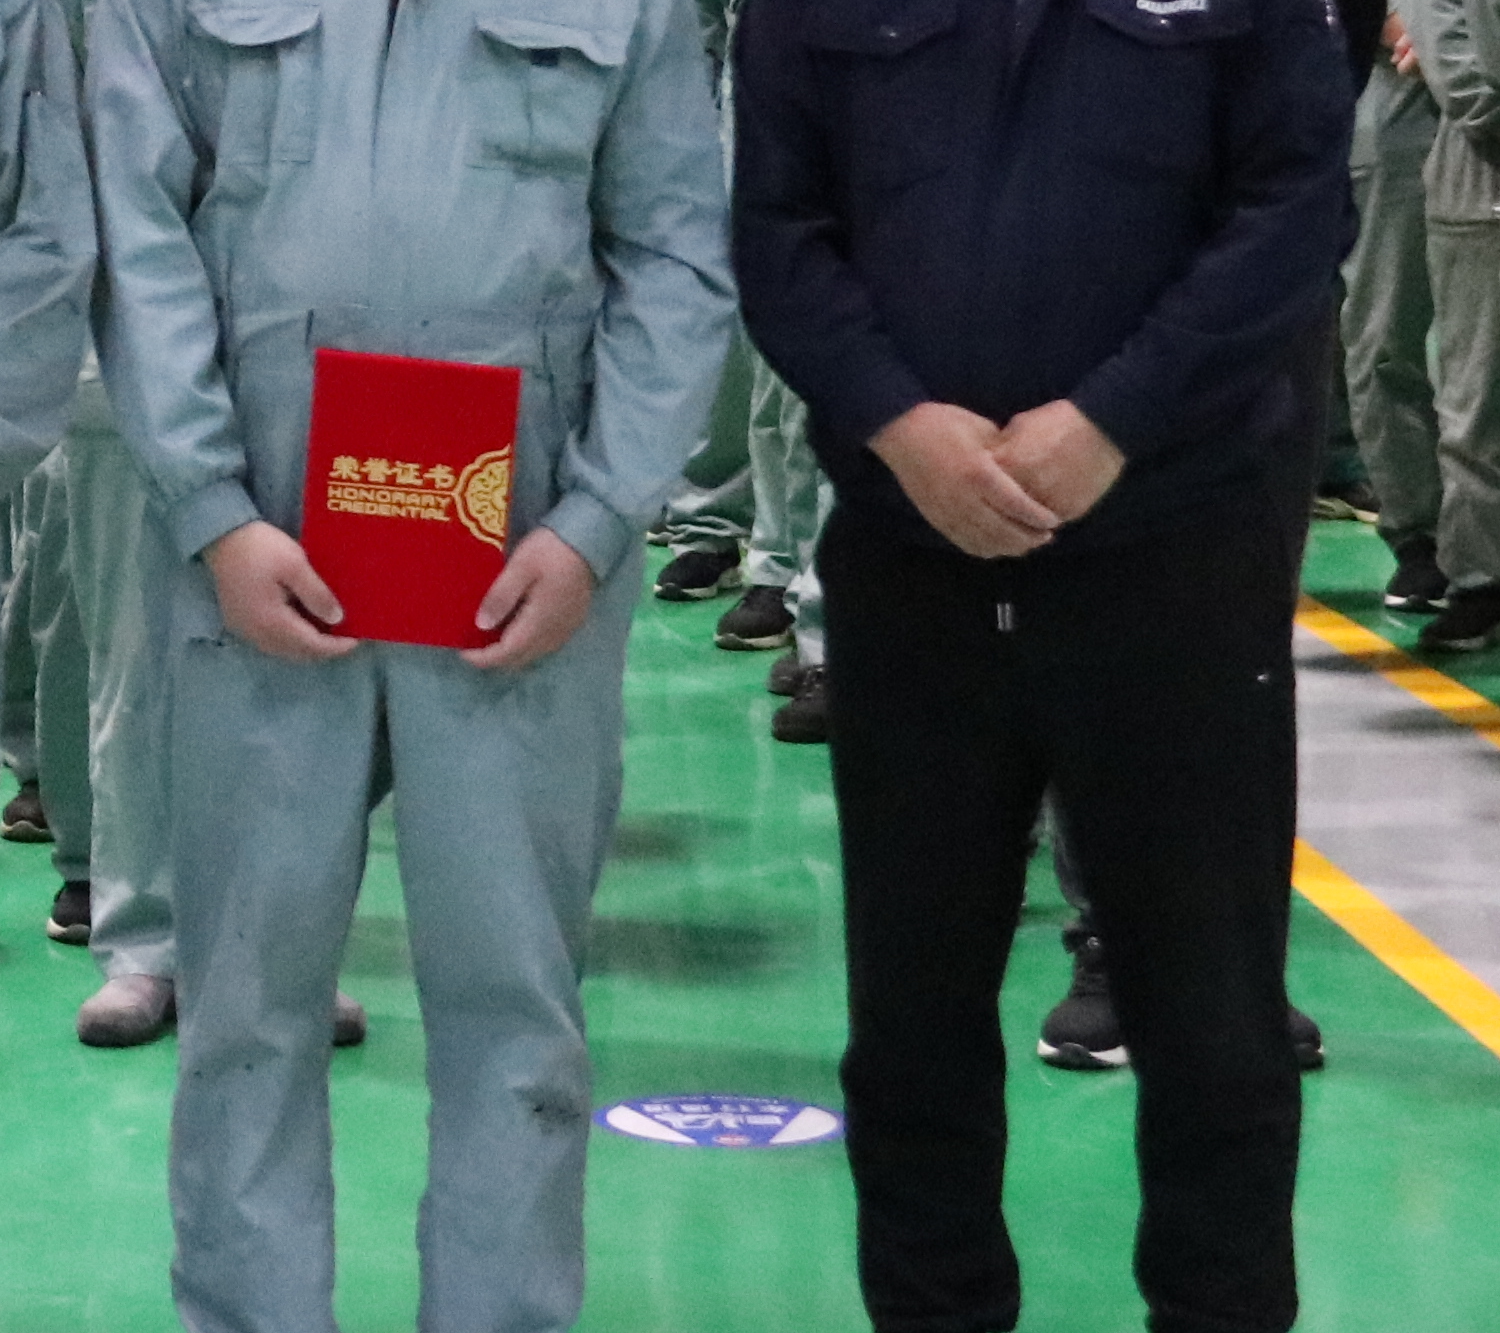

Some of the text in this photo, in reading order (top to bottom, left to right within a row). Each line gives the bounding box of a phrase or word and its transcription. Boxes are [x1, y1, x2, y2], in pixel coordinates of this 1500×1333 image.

[328, 454, 457, 489] 荣誉证书
[327, 485, 451, 509] HONORARY
[326, 498, 451, 522] CREDENTIAL
